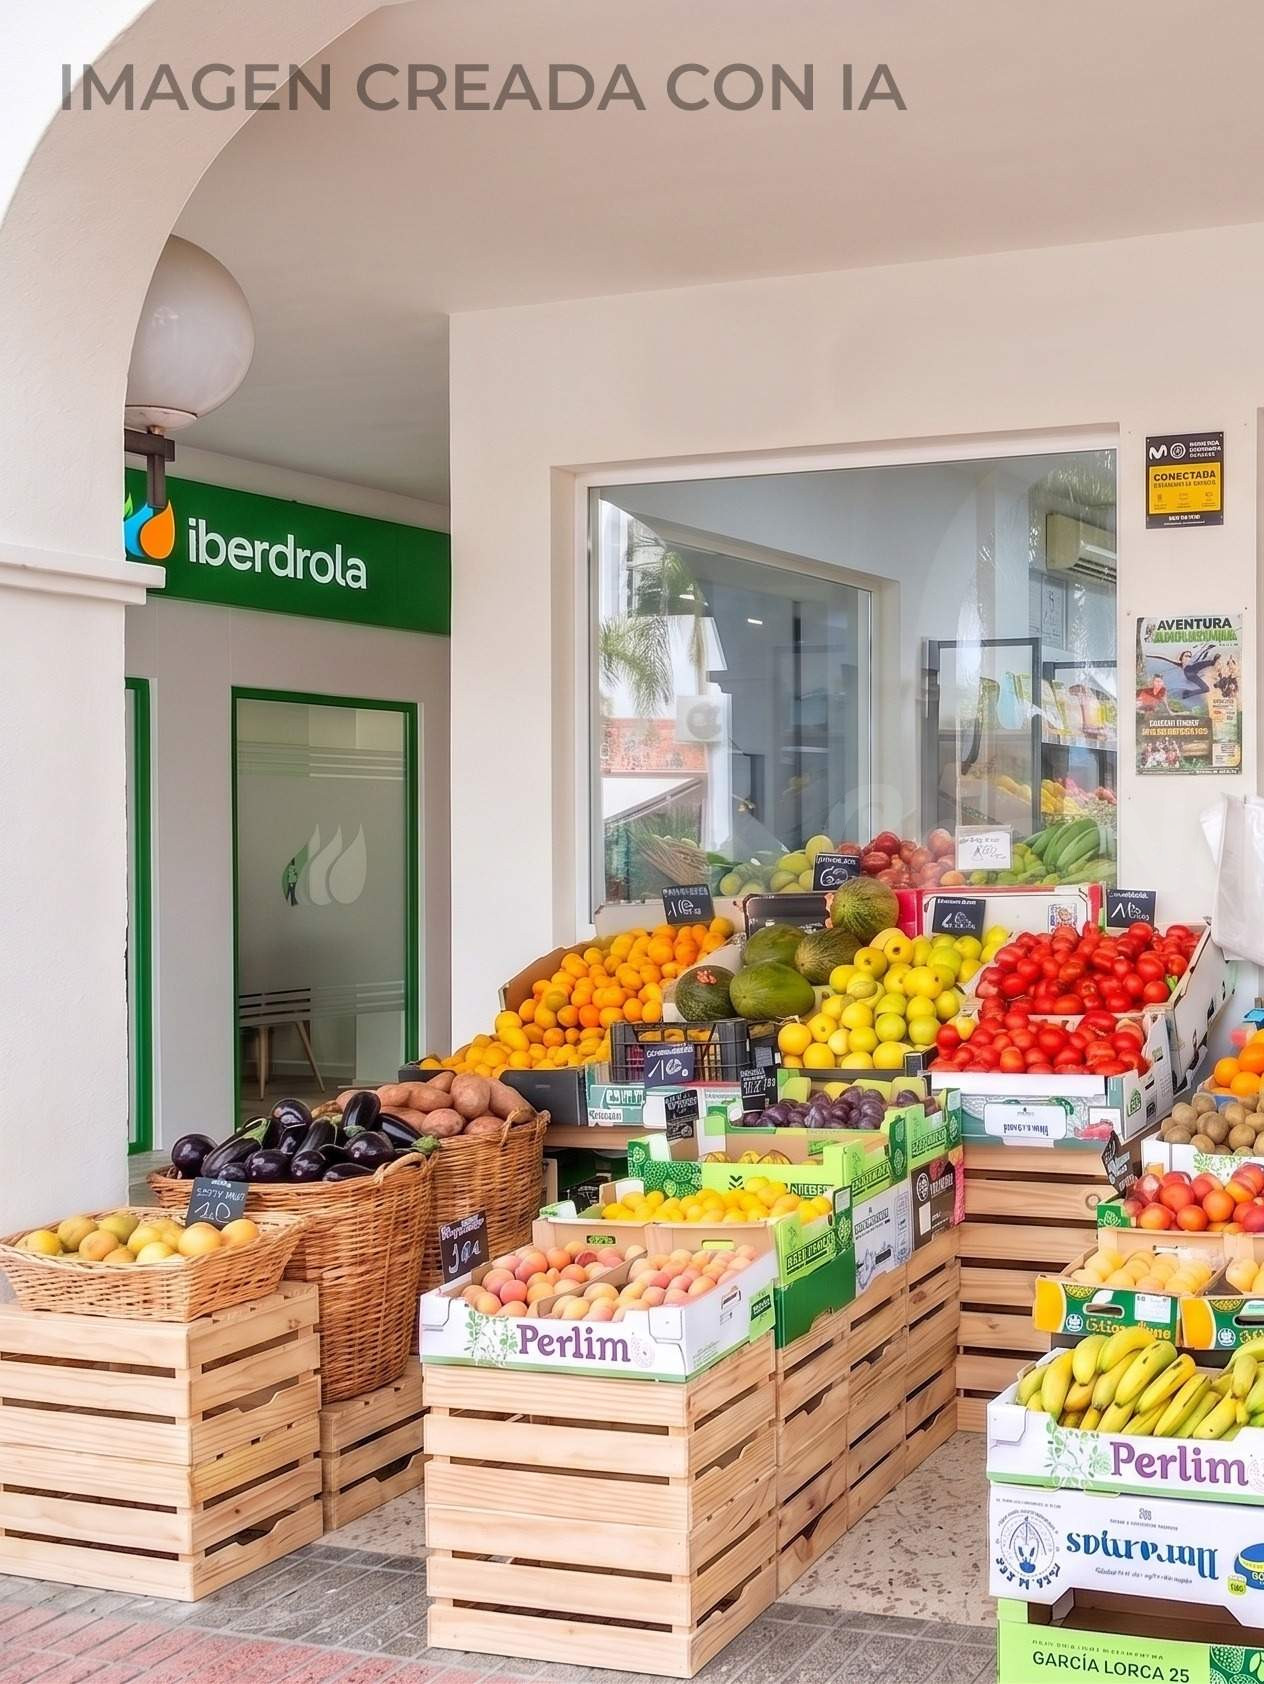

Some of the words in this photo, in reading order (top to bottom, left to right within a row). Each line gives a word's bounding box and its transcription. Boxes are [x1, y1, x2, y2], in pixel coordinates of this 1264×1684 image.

[188, 517, 368, 590] iberdrola
[1157, 617, 1233, 631] AVENTURA
[516, 1323, 632, 1364] Perlim
[1109, 1441, 1249, 1486] Perlim
[1032, 1650, 1100, 1674] GARCÍA
[1103, 1661, 1165, 1681] LORCA
[1168, 1667, 1190, 1684] 25
